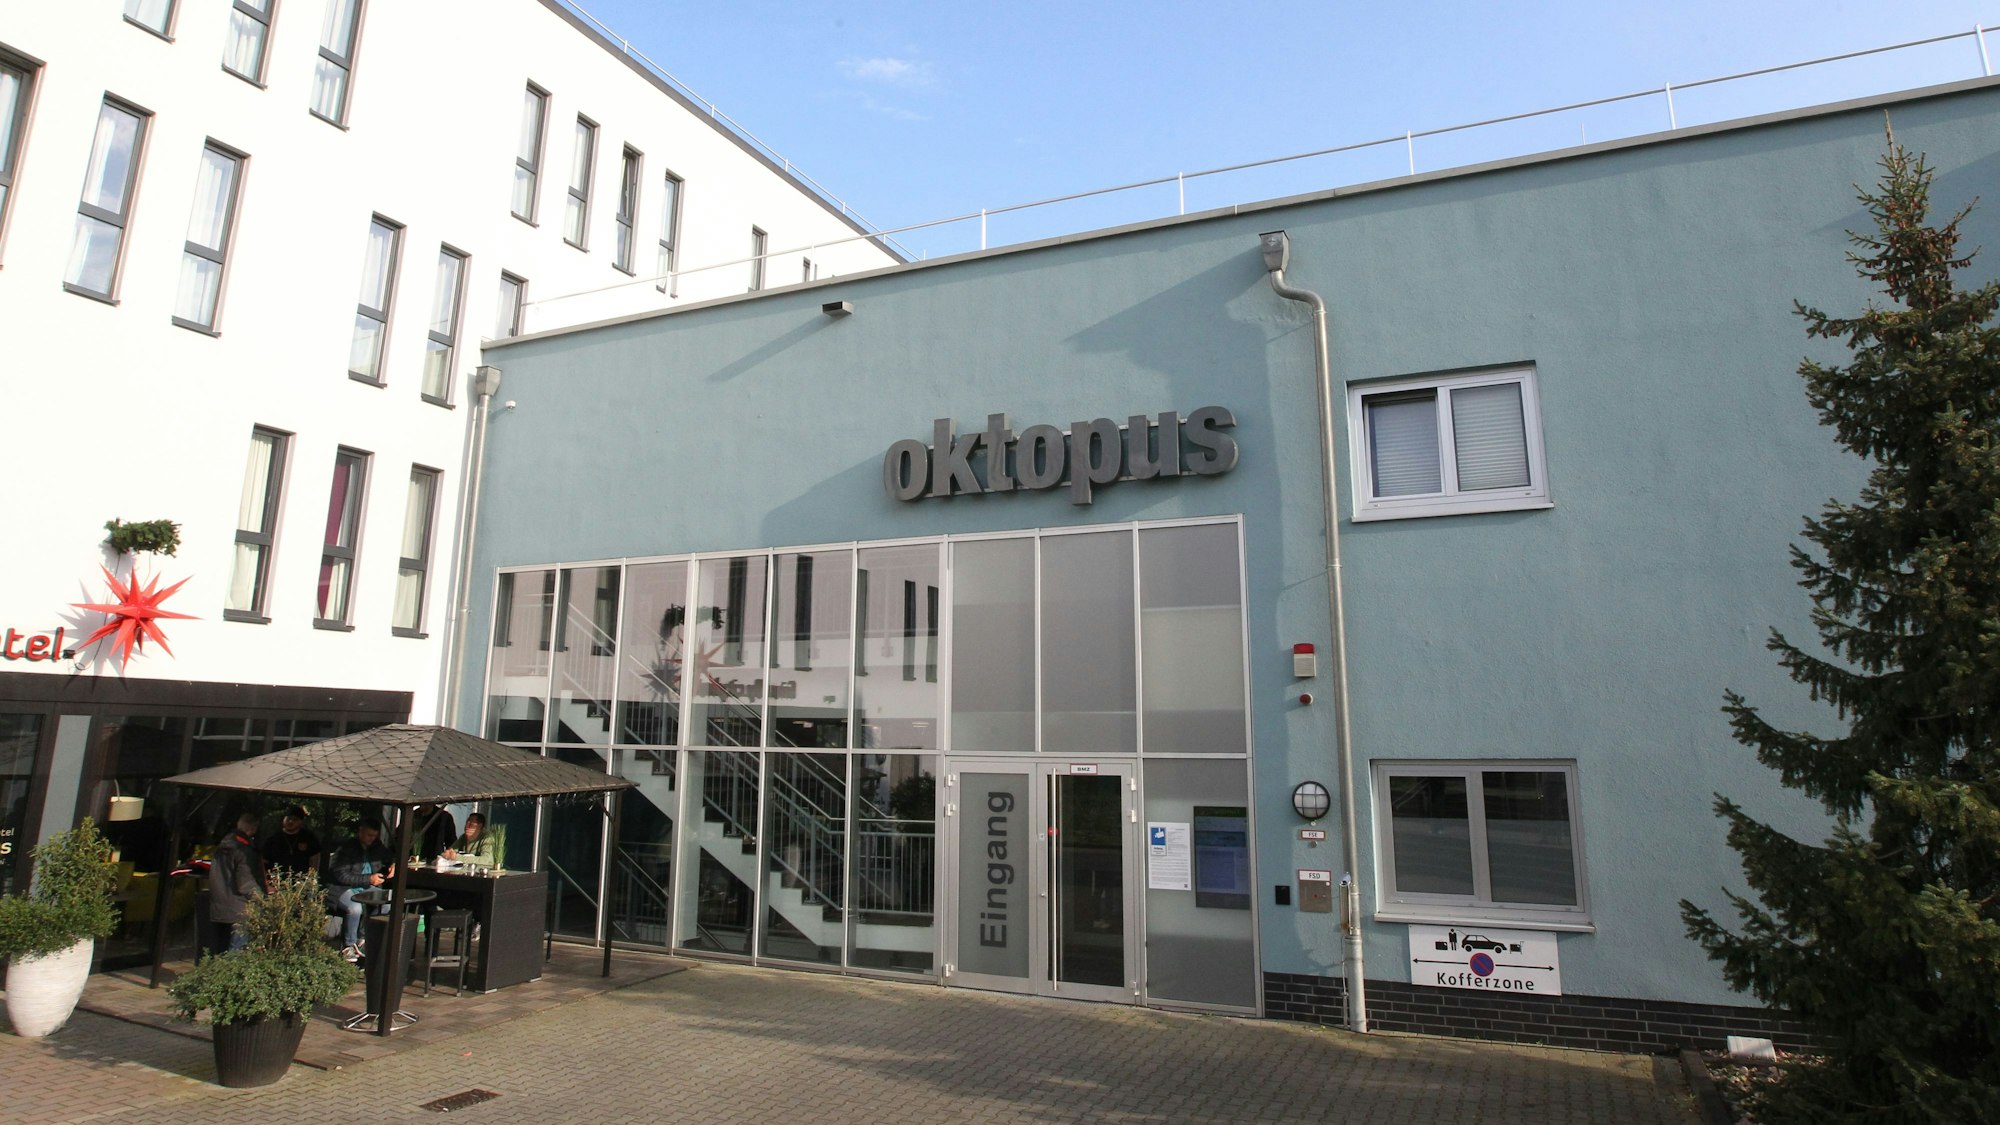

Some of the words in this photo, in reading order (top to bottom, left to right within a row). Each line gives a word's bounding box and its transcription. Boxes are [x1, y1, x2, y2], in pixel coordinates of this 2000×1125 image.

[883, 405, 1239, 506] oktopus
[0, 626, 64, 663] tel
[980, 791, 1015, 948] Eingang
[1437, 972, 1535, 991] Kofferzone
